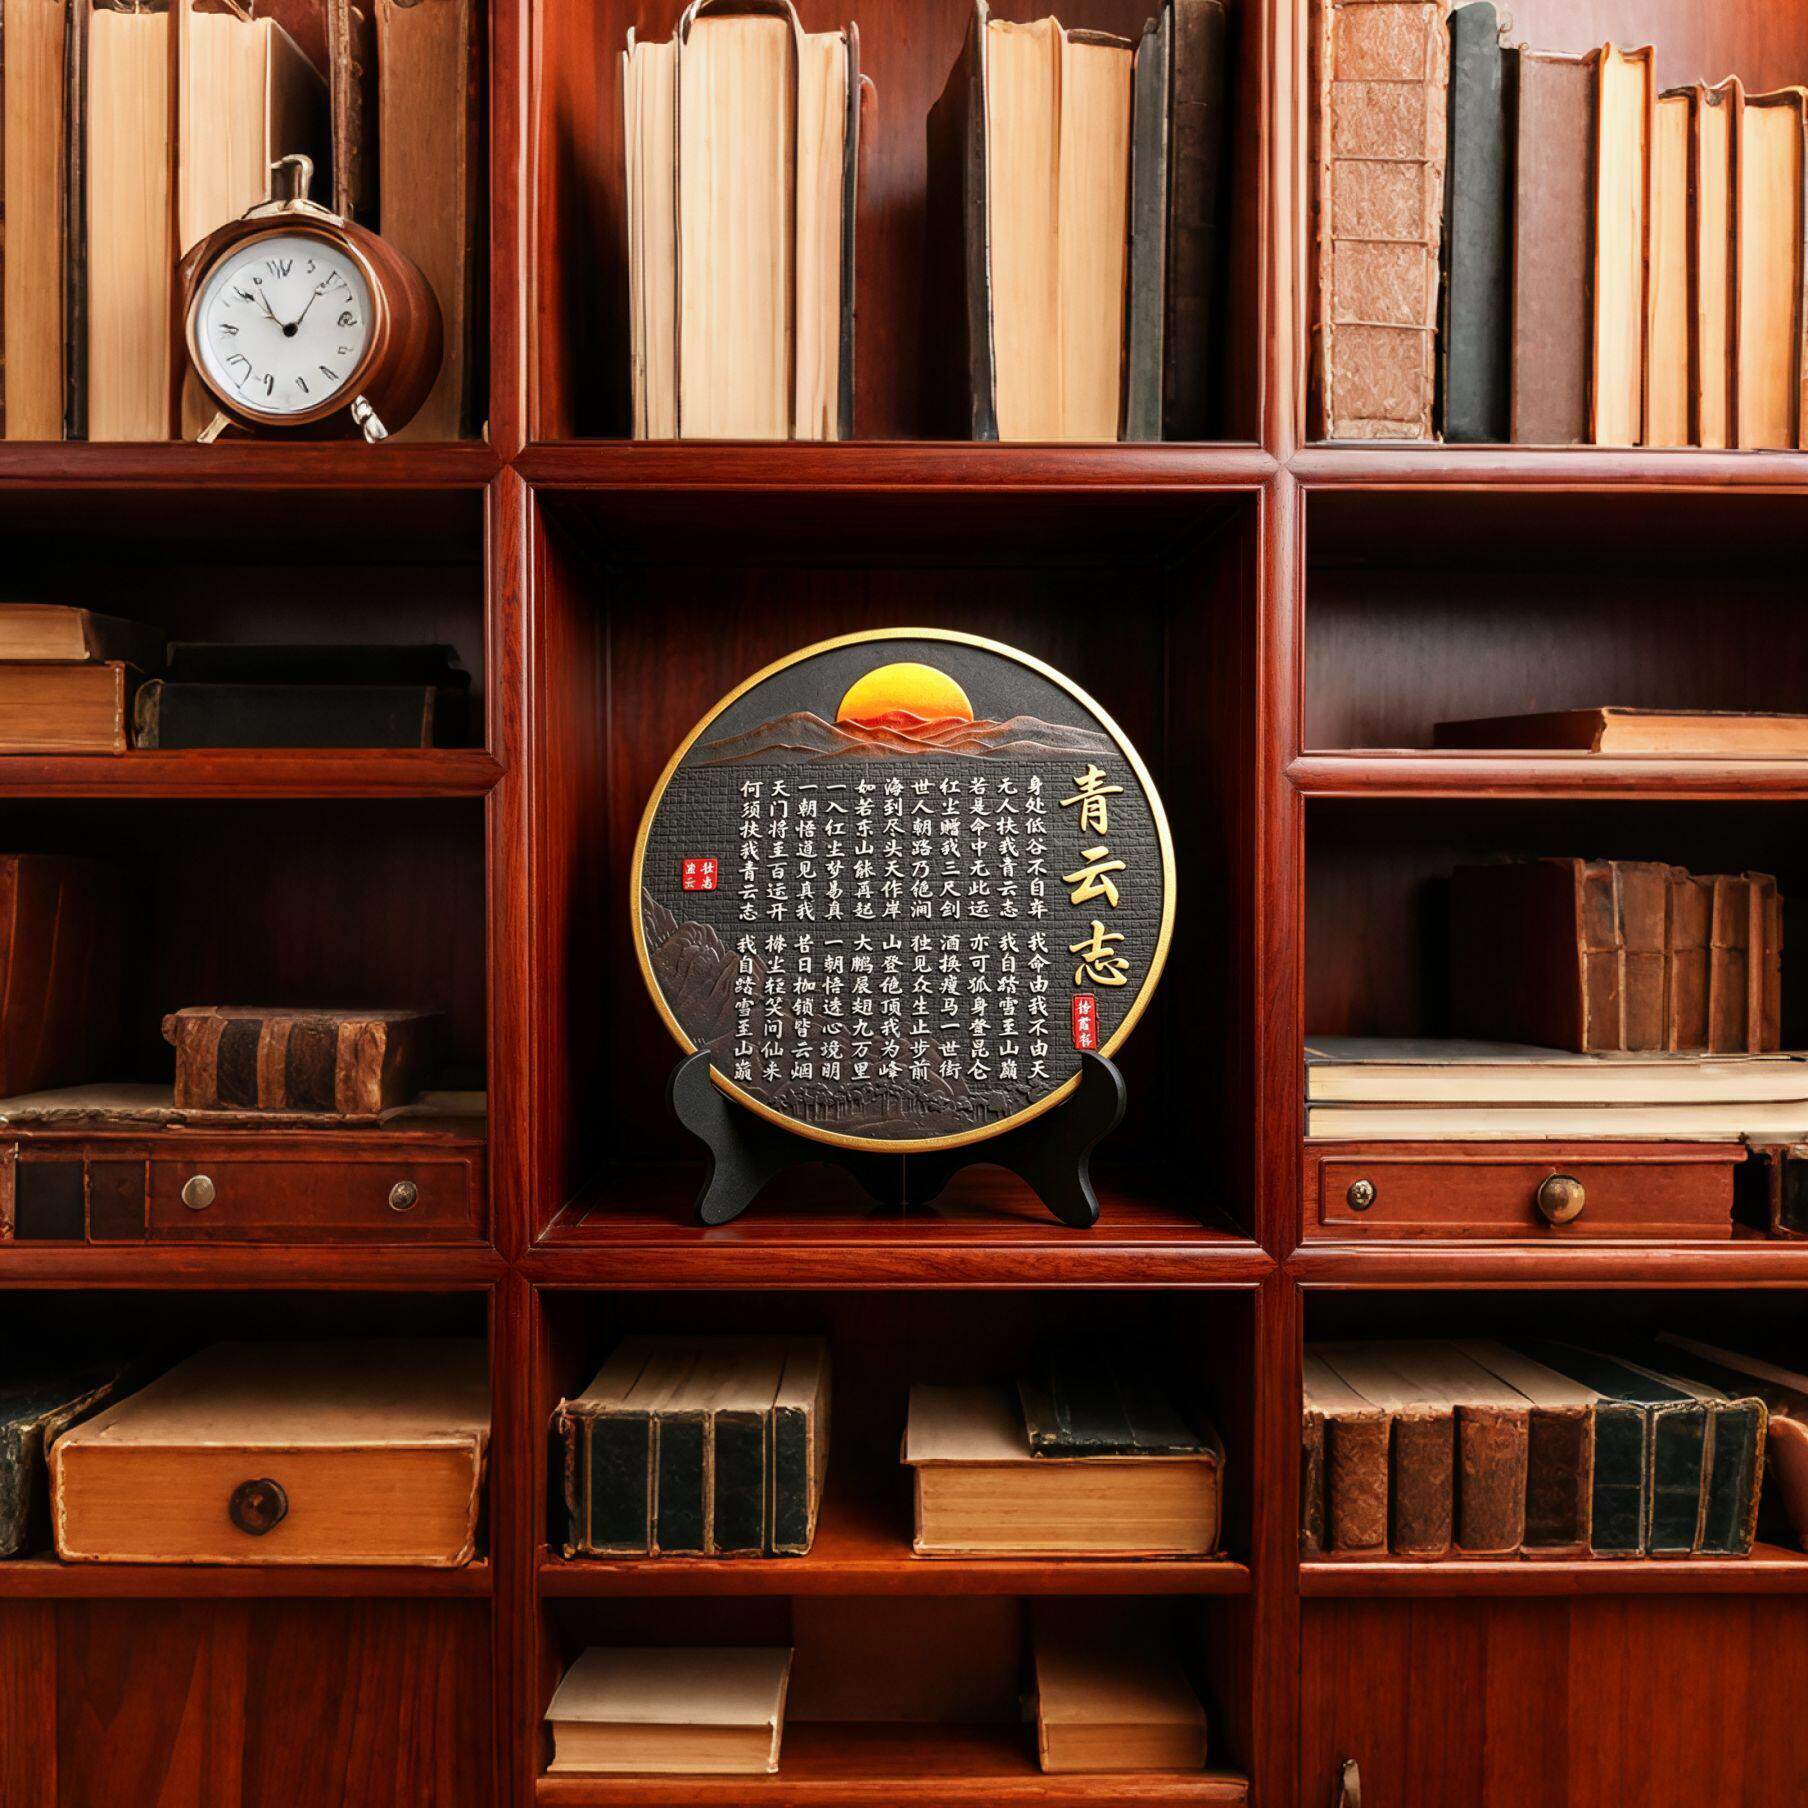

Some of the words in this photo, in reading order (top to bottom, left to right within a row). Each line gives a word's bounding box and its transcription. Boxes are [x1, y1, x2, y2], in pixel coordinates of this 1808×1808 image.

[795, 784, 818, 921] 一朝悟道见真我
[824, 784, 848, 920] 一入红尘梦易真
[852, 778, 877, 920] 如若东山能再起
[881, 776, 905, 920] 海到尽头天作岸
[968, 776, 991, 919] 若是命中无此运
[995, 776, 1019, 919] 无人扶我青云志
[1024, 775, 1048, 919] 身处低谷不自弃
[1059, 763, 1130, 987] 青云志
[851, 933, 874, 1081] 大鹏展翅九万里
[1027, 932, 1051, 1079] 我命由我不由天
